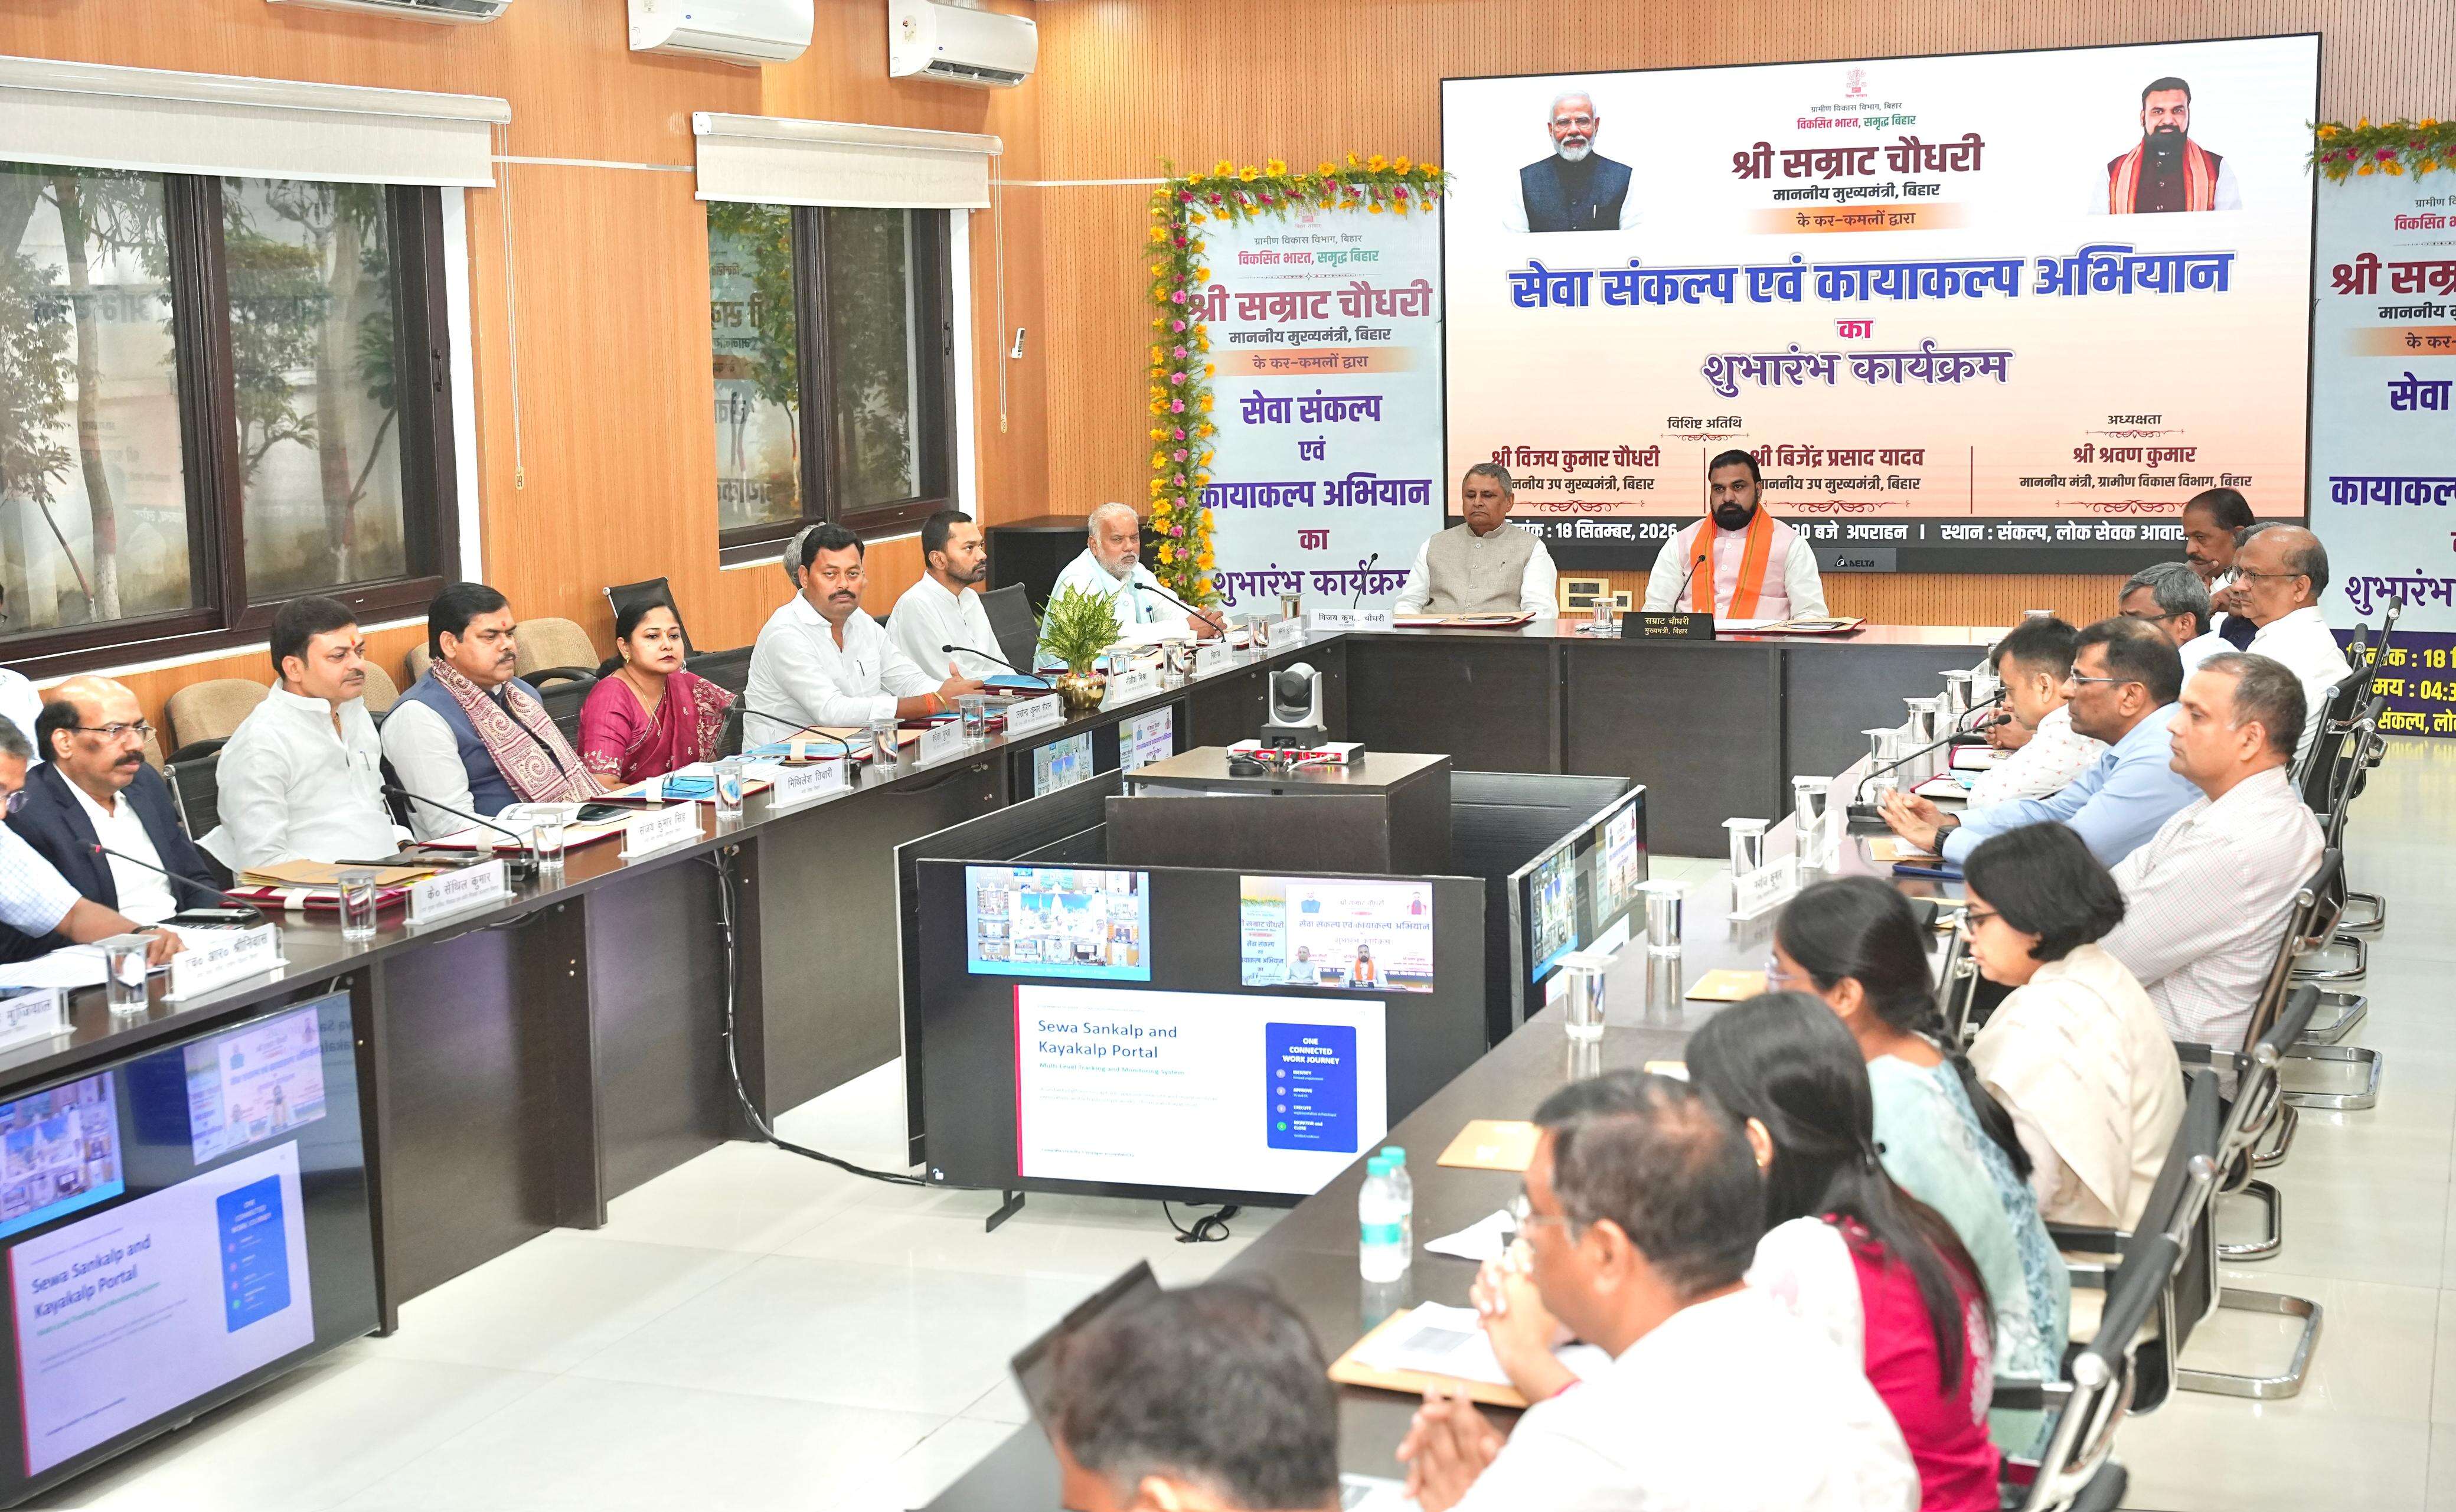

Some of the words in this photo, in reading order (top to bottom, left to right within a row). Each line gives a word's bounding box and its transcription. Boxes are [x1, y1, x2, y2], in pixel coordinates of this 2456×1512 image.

[1811, 104, 1831, 113] ग्रामीण
[1834, 103, 1857, 112] विकास
[1859, 103, 1881, 111] विभाग,
[1884, 102, 1902, 110] बिहार
[1797, 117, 1832, 130] विकसित
[1834, 117, 1861, 129] भारत,
[1863, 116, 1889, 130] समृद्ध
[1892, 113, 1916, 126] बिहार
[1732, 141, 1775, 179] श्री
[1781, 146, 1879, 179] सम्राट
[1885, 133, 1985, 174] चौधरी
[1772, 185, 1830, 201] माननीय
[1833, 182, 1899, 203] मुख्यमंत्री,
[1902, 181, 1941, 197] बिहार
[2415, 197, 2445, 208] ग्रामीण
[1796, 213, 1811, 227] के
[1814, 210, 1886, 227] कर-कमलों
[1888, 212, 1916, 226] द्वारा
[2394, 213, 2446, 230] विकसित
[1254, 235, 1279, 246] ग्रामीण
[1281, 234, 1309, 245] विकास
[1311, 234, 1338, 246] विभाग,
[1341, 234, 1362, 244] बिहार
[1238, 250, 1281, 265] विकसित
[1283, 250, 1315, 266] भारत,
[1317, 249, 1348, 267] समृद्ध
[1350, 247, 1379, 263] बिहार
[1508, 260, 1593, 308] सेवा
[1599, 259, 1739, 306] संकल्प
[1745, 254, 1807, 303] एवं
[1812, 260, 2026, 302] कायाकल्प
[2034, 244, 2235, 296] अभियान
[2330, 253, 2382, 295] श्री
[1188, 284, 1230, 322] श्री
[1235, 290, 1331, 323] सम्राट
[1337, 279, 1433, 318] चौधरी
[2378, 301, 2445, 319] माननीय
[1229, 327, 1284, 344] माननीय
[1288, 326, 1352, 346] मुख्यमंत्री,
[1354, 325, 1392, 341] बिहार
[1836, 319, 1874, 339] का
[2405, 332, 2422, 349] के
[1252, 355, 1265, 370] के
[1270, 353, 1338, 369] कर-कमलों
[1343, 355, 1369, 368] द्वारा
[1704, 344, 1838, 398] शुभारंभ
[1848, 339, 2013, 385] कार्यक्रम
[2388, 371, 2452, 411] सेवा
[1240, 389, 1293, 424] सेवा
[1299, 388, 1383, 423] संकल्प
[1667, 416, 1702, 429] विशिष्ट
[1706, 416, 1742, 429] अतिथि
[2108, 414, 2162, 425] अध्यक्षता
[1298, 435, 1327, 461] एवं
[1750, 444, 1772, 466] श्री
[1776, 444, 1824, 468] बिजेंद्र
[1828, 448, 1874, 467] प्रसाद
[1879, 448, 1925, 466] यादव
[2073, 443, 2095, 463] श्री
[2098, 446, 2143, 464] श्रवण
[2145, 446, 2197, 468] कुमार
[1491, 446, 1512, 467] श्री
[1515, 446, 1559, 467] विजय
[1562, 449, 1609, 473] कुमार
[1612, 445, 1660, 467] चौधरी
[1199, 481, 1316, 509] कायाकल्प
[1323, 472, 1432, 507] अभियान
[1511, 475, 1544, 489] ननीय
[1547, 479, 1562, 489] उप
[1565, 476, 1620, 494] मुख्यमंत्री,
[1622, 476, 1654, 489] बिहार
[1761, 475, 1804, 489] ाननीय
[1805, 479, 1823, 489] उप
[1825, 475, 1884, 494] मुख्यमंत्री,
[1887, 475, 1920, 489] बिहार
[2019, 474, 2067, 488] माननीय
[2069, 474, 2095, 489] मंत्री,
[2098, 474, 2135, 488] ग्रामीण
[2138, 474, 2175, 487] विकास
[2179, 474, 2217, 488] विभाग,
[2219, 473, 2252, 487] बिहार
[1298, 529, 1330, 550] का
[1556, 523, 1572, 538] 18
[1576, 519, 1635, 541] सितम्बर,
[1639, 523, 1677, 539] 2026
[1814, 520, 1839, 540] बजे
[1846, 524, 1908, 540] अपराहन
[1941, 525, 1985, 540] स्थान
[1997, 520, 2052, 543] संकल्प,
[2055, 520, 2092, 540] लोक
[2094, 521, 2137, 540] सेवक
[1212, 563, 1305, 607] शुभारंभ
[1319, 612, 1337, 621] विजय
[1364, 613, 1384, 622] चौधरी
[1667, 616, 1689, 625] चौधरी
[1644, 626, 1671, 635] मुख्यमंत्री,
[2424, 649, 2446, 668] 18
[2372, 678, 2405, 697] मय
[2378, 707, 2429, 734] संकल्प,
[788, 773, 812, 789] मिथिलेश
[815, 766, 832, 781] तिवारी
[657, 817, 672, 832] कुमार
[471, 873, 491, 890] कुमार
[1038, 1020, 1077, 1033] Sewa
[1084, 1022, 1143, 1039] Sankalp
[1149, 1026, 1177, 1038] and
[1039, 1041, 1106, 1058] Kayakalp
[1113, 1045, 1158, 1058] Portal
[1282, 1055, 1305, 1063] WORK
[1289, 1047, 1332, 1055] CONNECTED
[31, 1271, 69, 1294] Sewa
[71, 1248, 124, 1278] Sankalp
[127, 1233, 151, 1256] and
[98, 1263, 138, 1293] Portal
